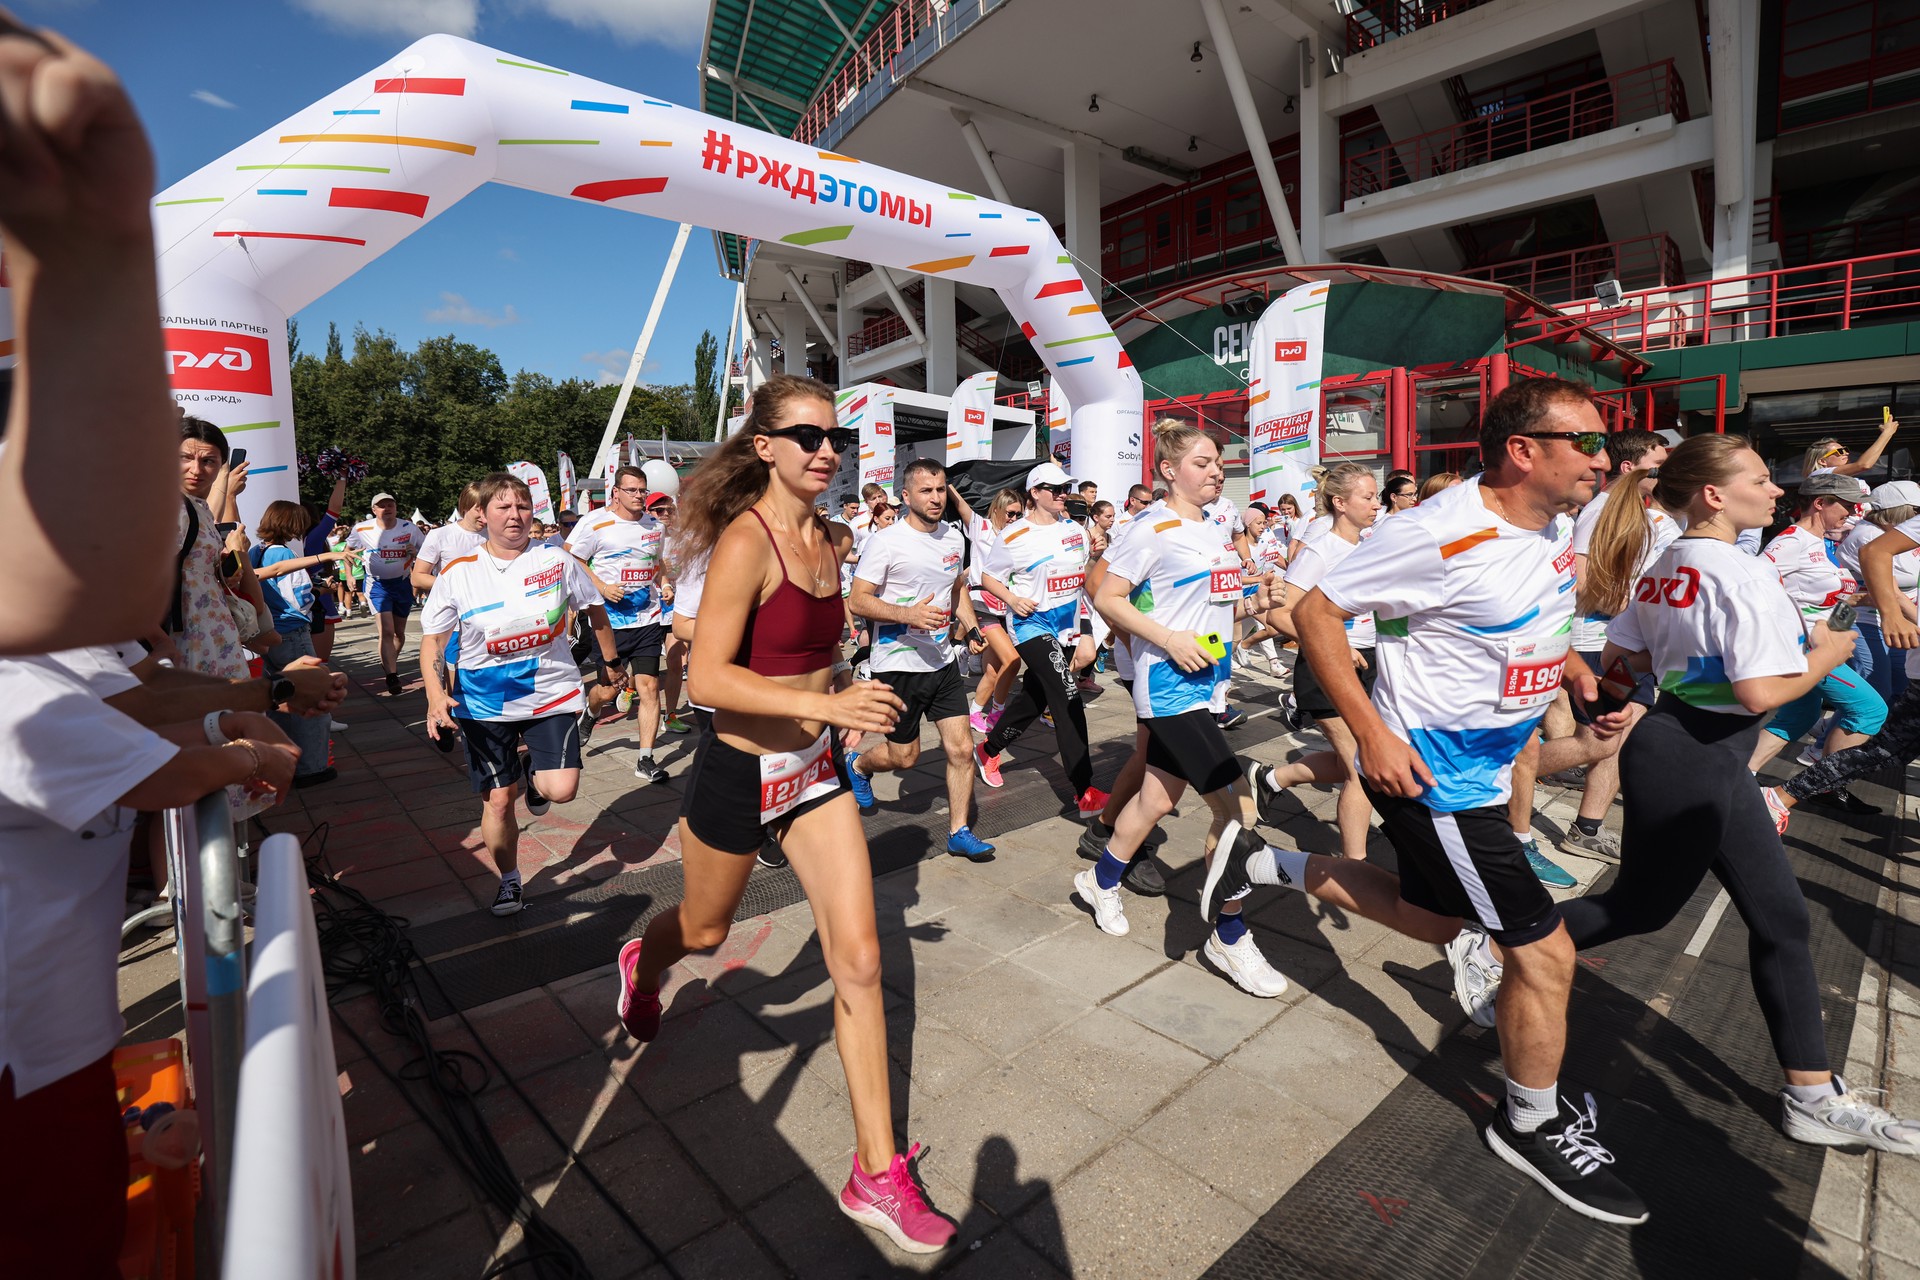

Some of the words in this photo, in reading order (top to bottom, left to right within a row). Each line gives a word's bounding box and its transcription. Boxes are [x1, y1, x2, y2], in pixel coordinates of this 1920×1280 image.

[702, 129, 932, 228] #РЖДЭТОМЫ
[221, 320, 268, 334] ПАРТНЕР
[1280, 345, 1302, 357] РЖД
[175, 393, 200, 402] ОАО
[204, 395, 241, 404] «РЖД»
[1257, 413, 1309, 436] ДОСТИГАЯ
[1346, 413, 1355, 424] WC
[1272, 424, 1308, 440] ЦЕЛИ!
[627, 571, 649, 580] 1869
[1055, 577, 1079, 590] 1690
[498, 633, 540, 654] 3027
[776, 761, 820, 804] 2179
[765, 784, 774, 809] 1520м
